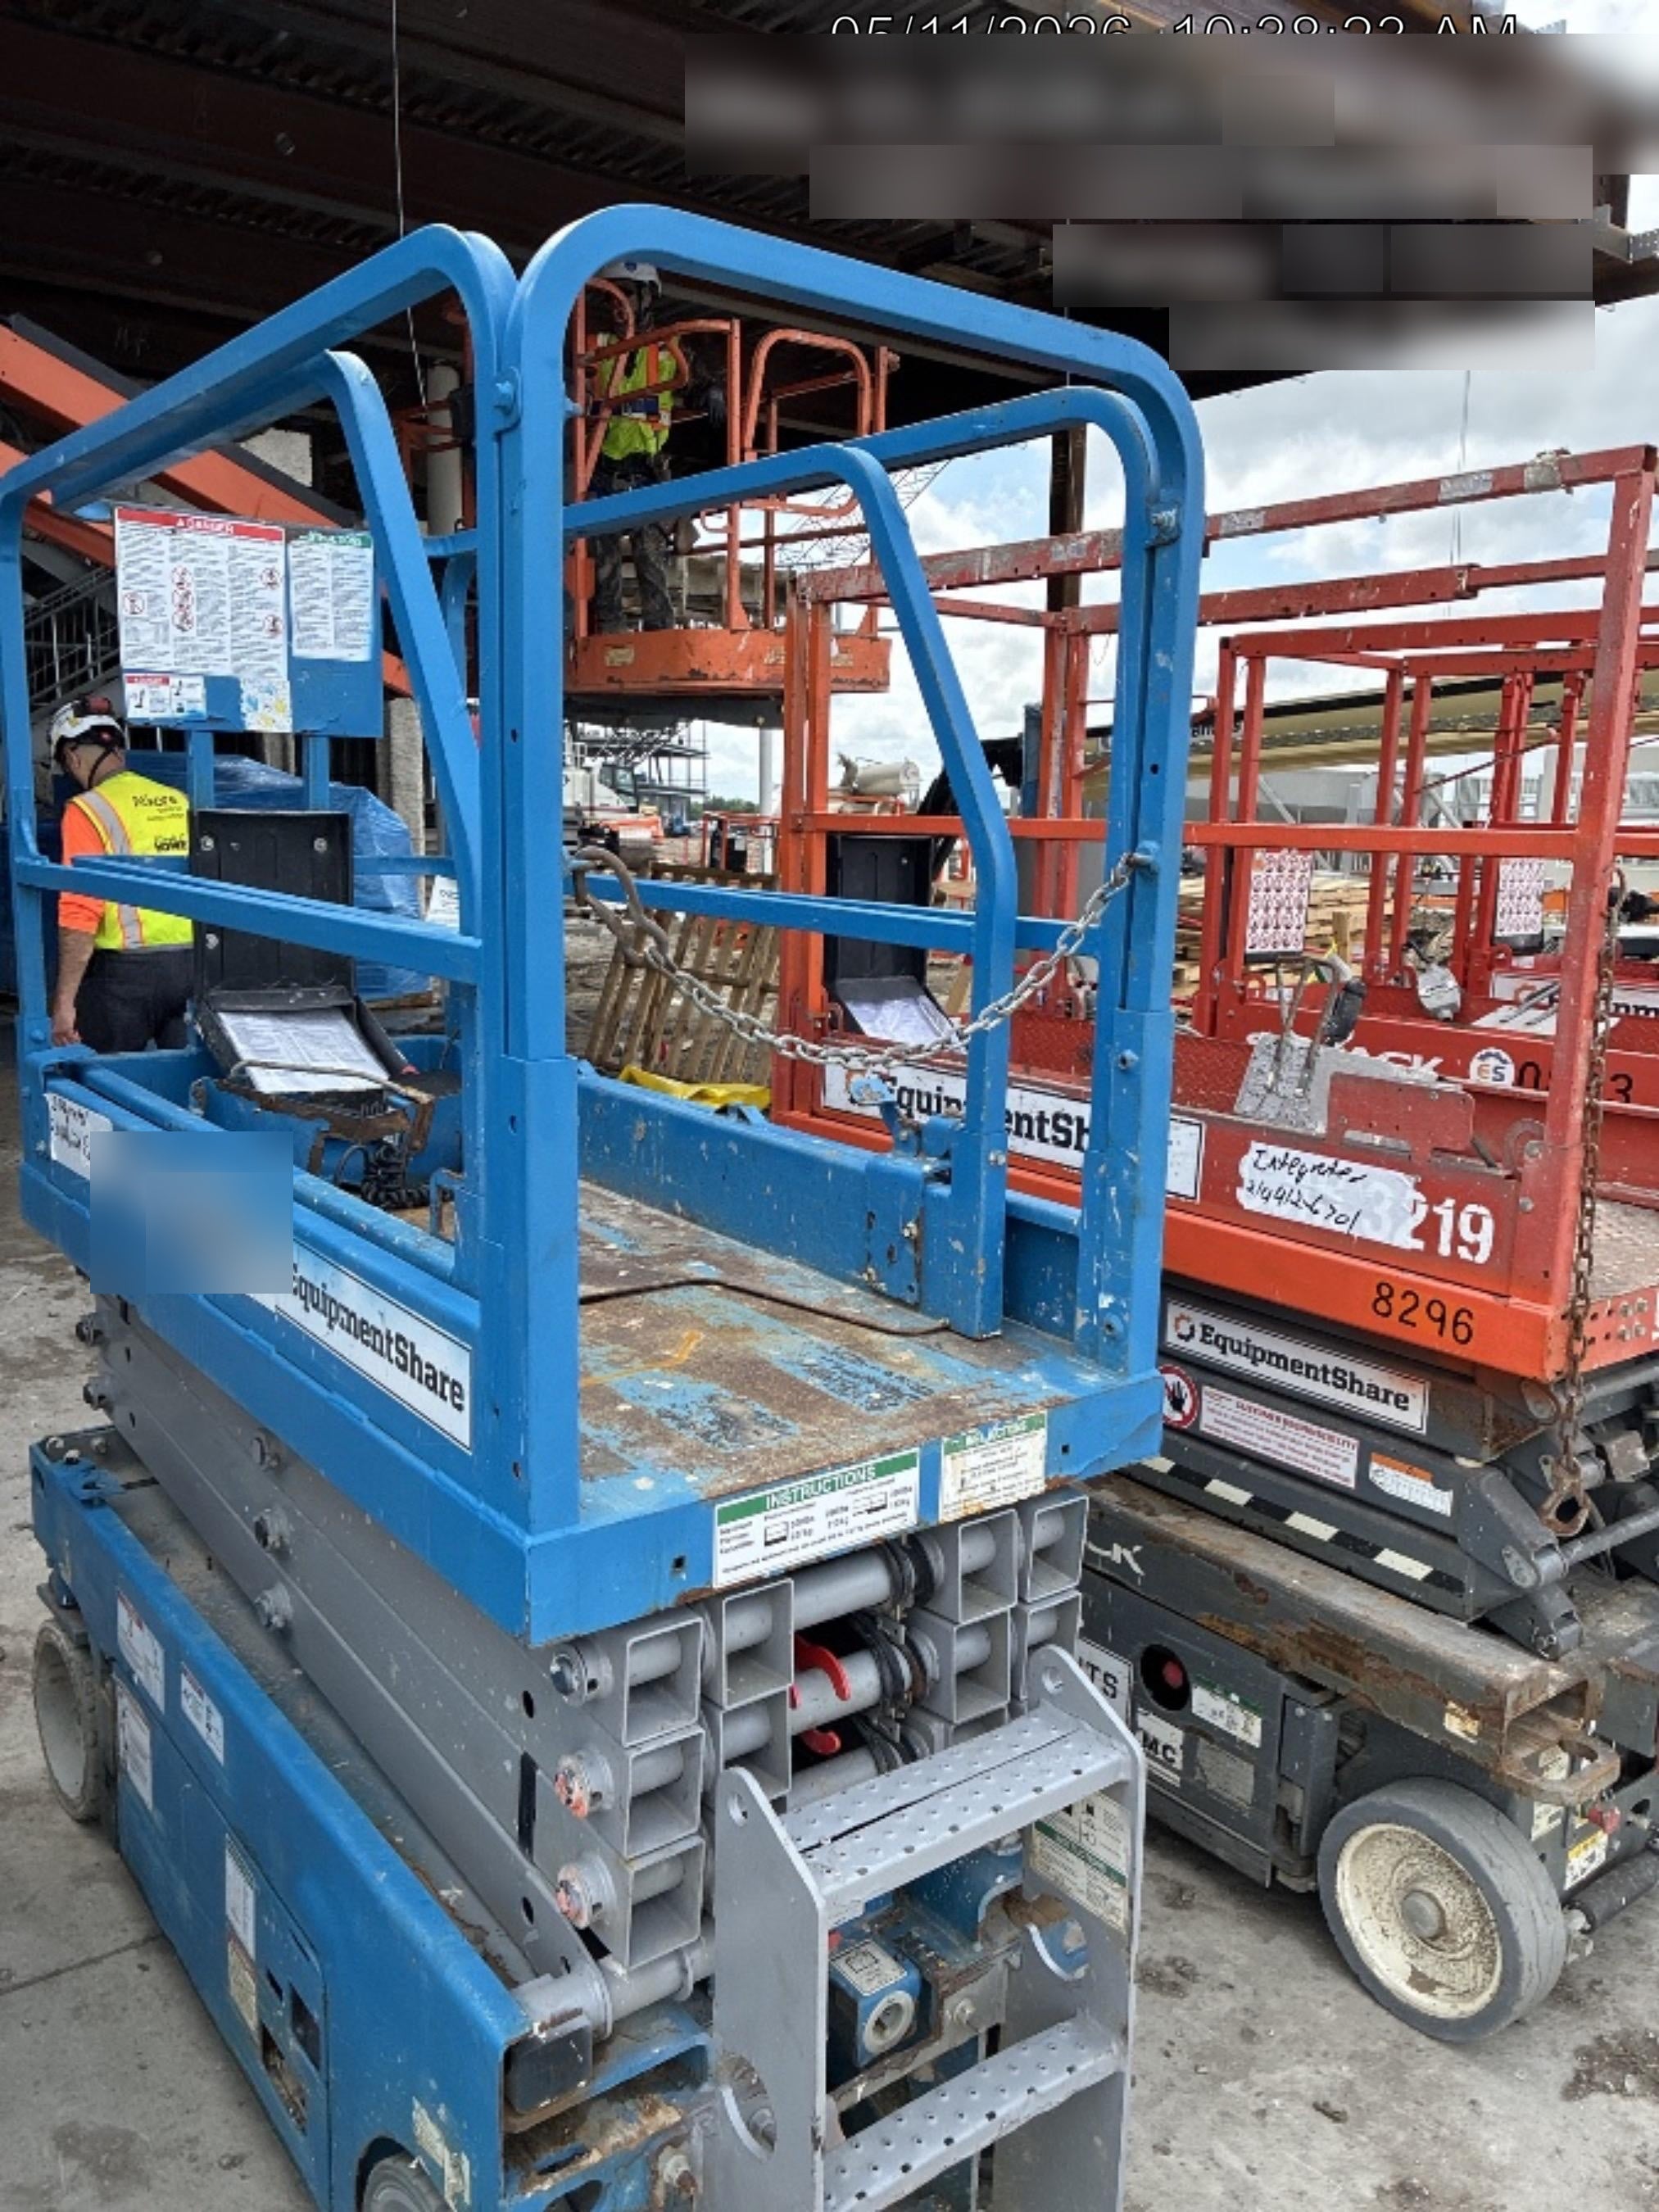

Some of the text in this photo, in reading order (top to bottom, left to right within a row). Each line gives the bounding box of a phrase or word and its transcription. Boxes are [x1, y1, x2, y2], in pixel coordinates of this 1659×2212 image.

[1477, 1064, 1506, 1082] ES
[1371, 1281, 1475, 1345] 8296
[1199, 1322, 1410, 1412] EquipmentShare
[765, 1465, 877, 1511] INSTRUCTIONS
